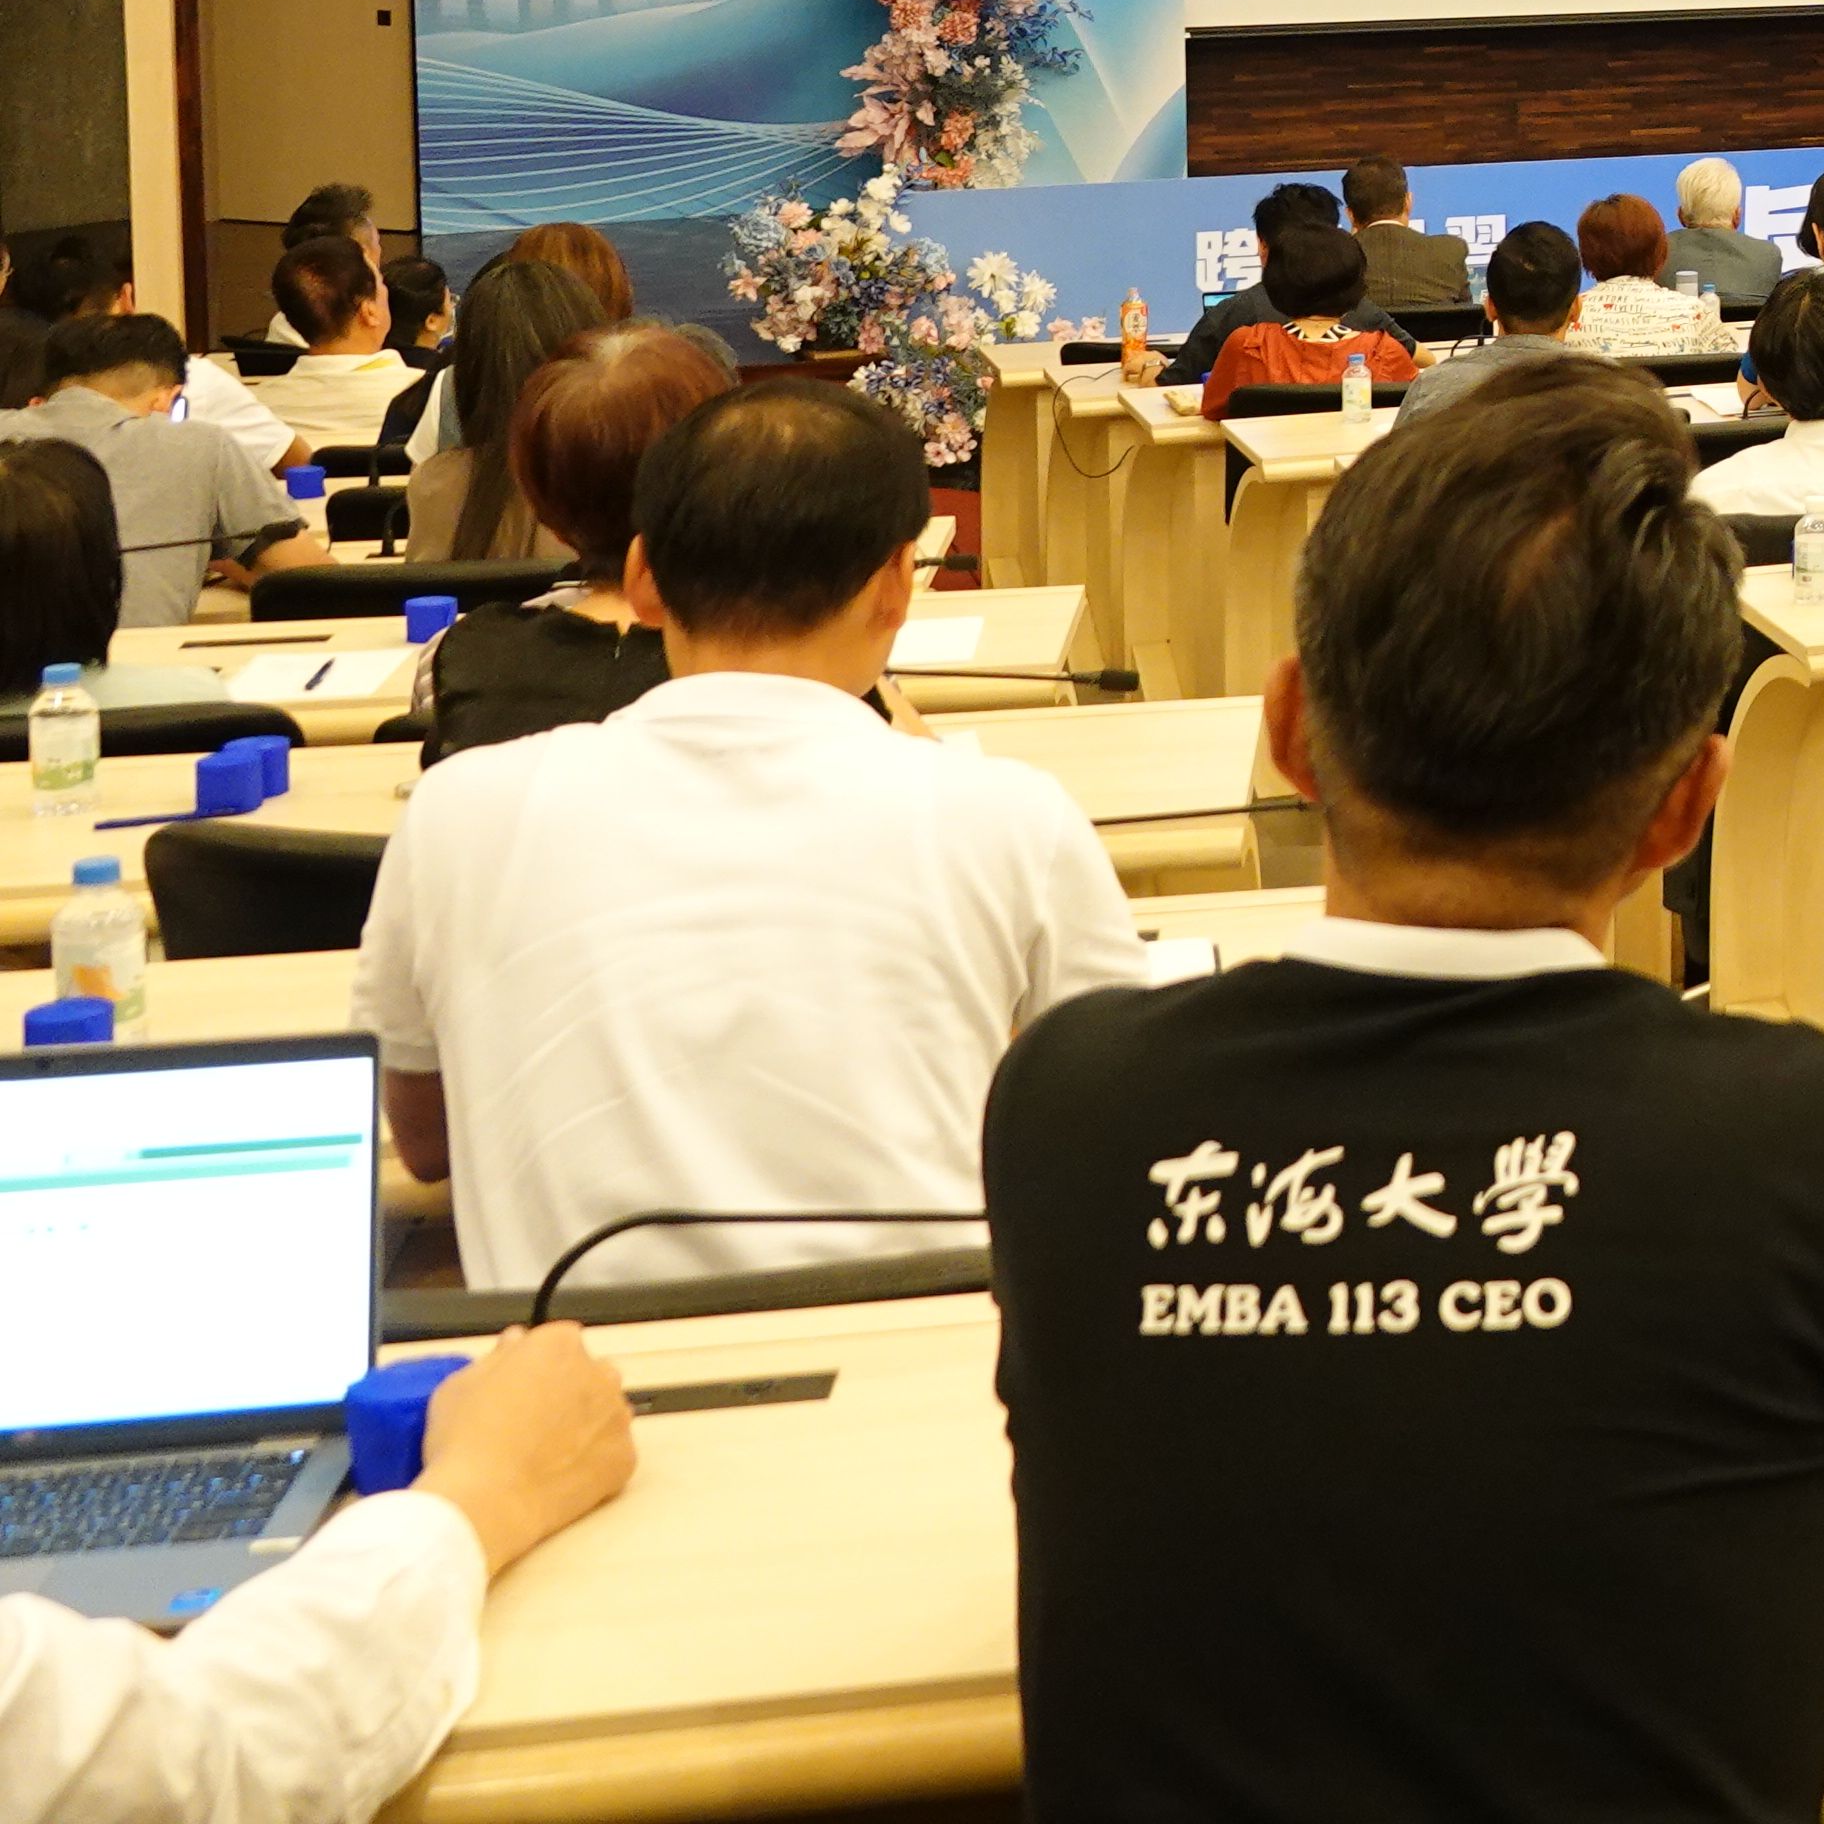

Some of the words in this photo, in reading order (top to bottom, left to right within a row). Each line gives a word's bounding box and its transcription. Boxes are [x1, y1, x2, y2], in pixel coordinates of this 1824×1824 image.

[1140, 1284, 1308, 1336] EMBA
[1328, 1281, 1421, 1334] 113
[1439, 1277, 1573, 1331] CEO
